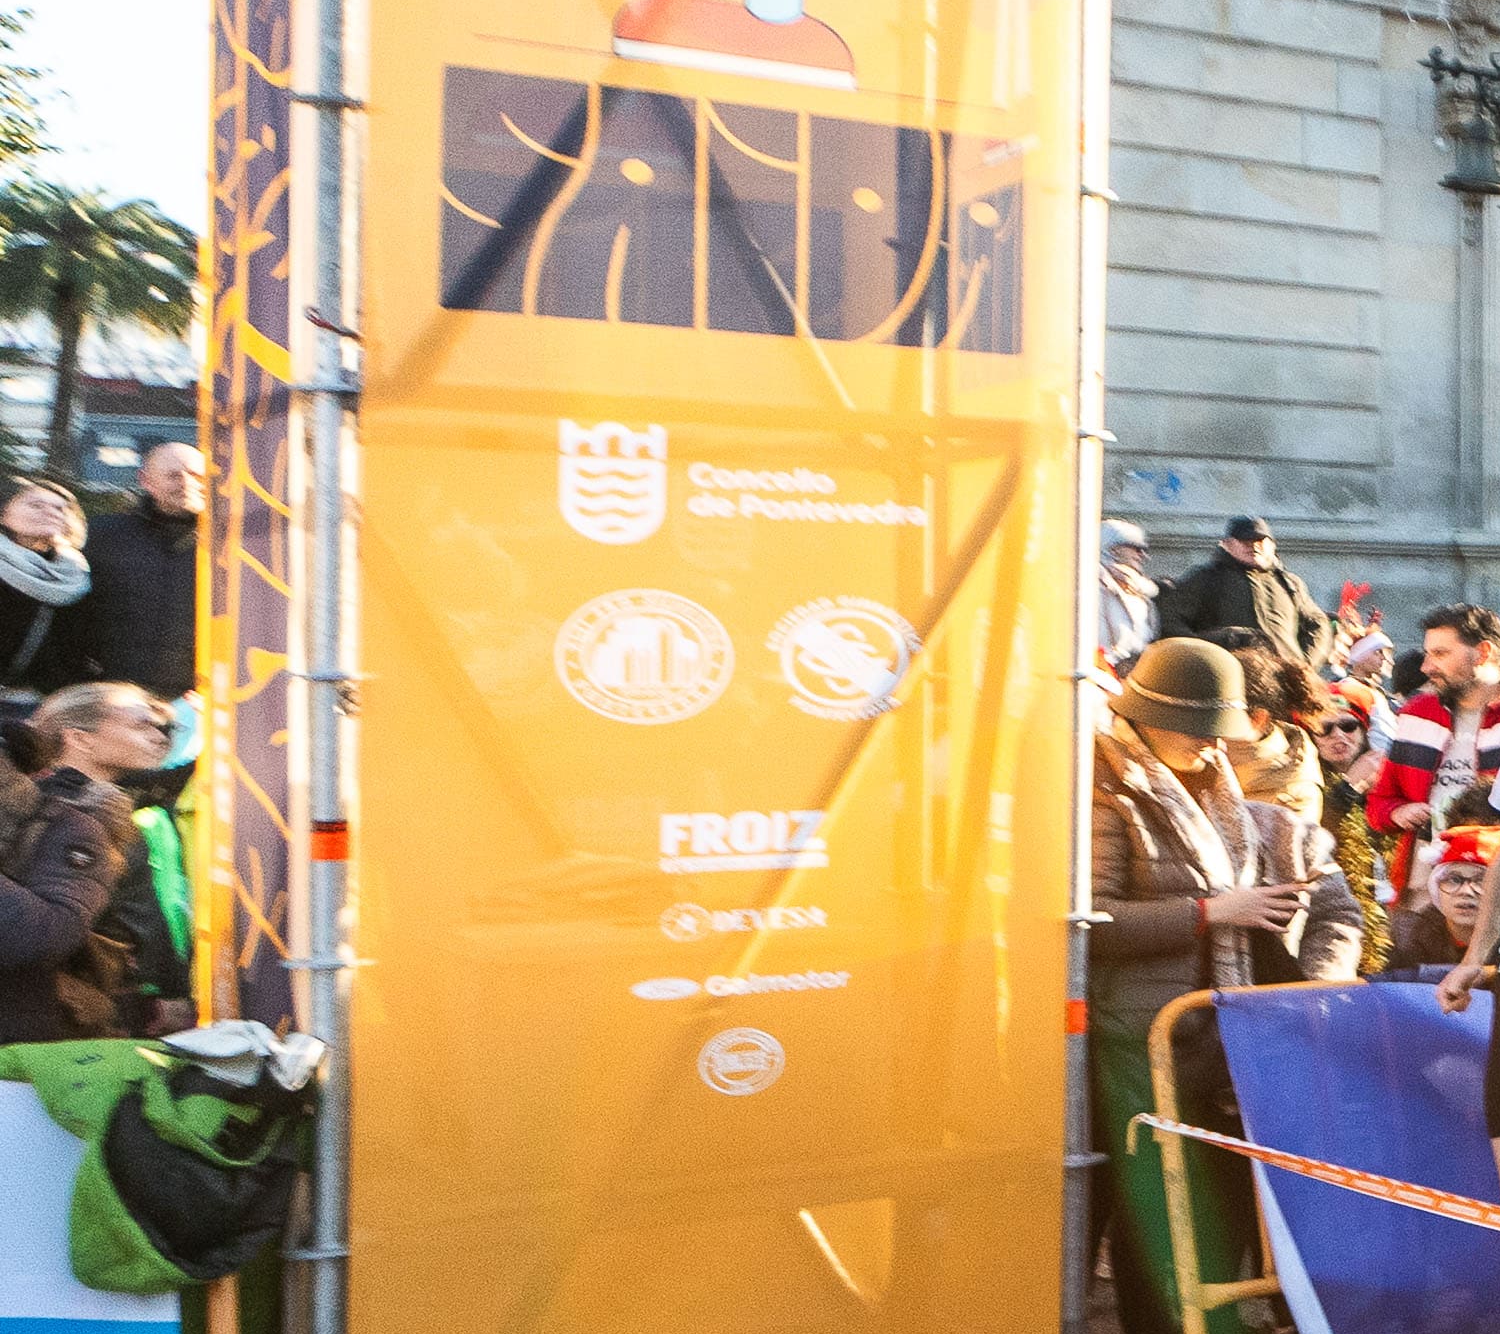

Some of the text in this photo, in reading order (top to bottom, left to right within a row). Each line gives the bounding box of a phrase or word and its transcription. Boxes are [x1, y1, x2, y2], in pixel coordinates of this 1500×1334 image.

[688, 462, 837, 493] Concello
[687, 493, 928, 526] de Pontevedra
[660, 810, 828, 855] FROIZ
